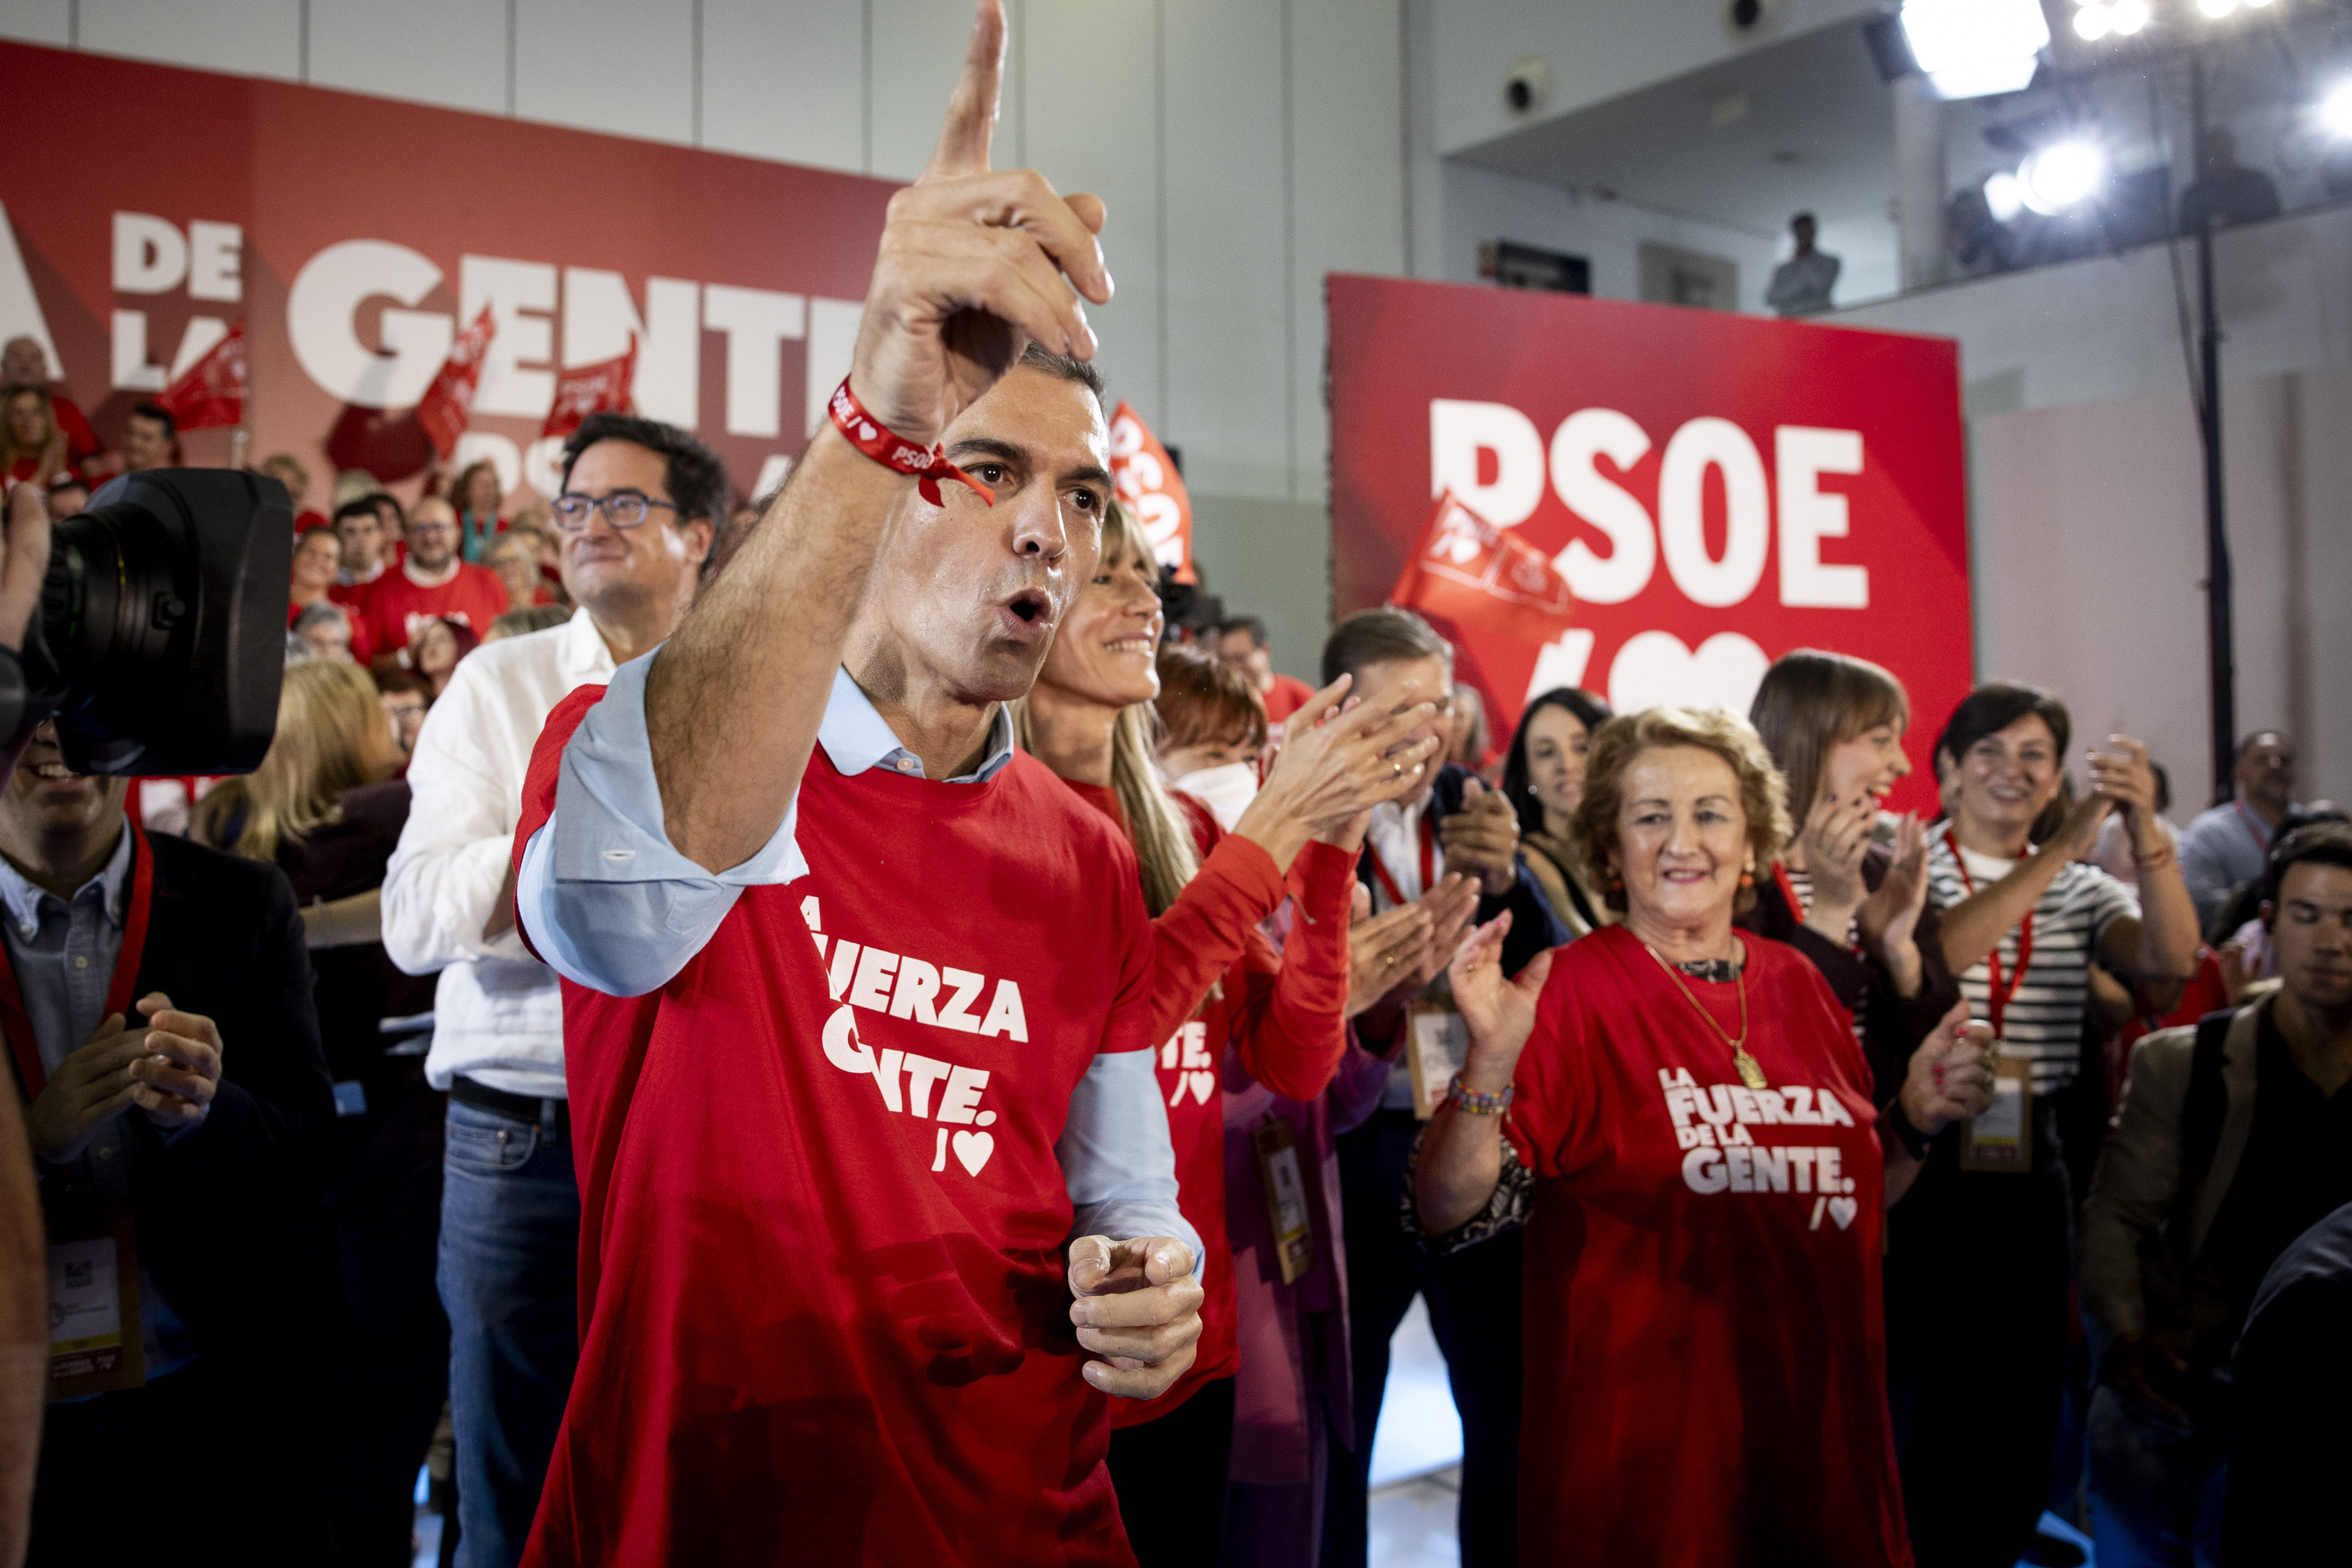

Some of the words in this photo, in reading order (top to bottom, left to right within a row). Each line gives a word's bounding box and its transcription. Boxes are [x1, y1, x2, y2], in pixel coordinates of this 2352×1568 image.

[112, 210, 243, 302] DE
[1429, 397, 1870, 610] PSOE
[811, 933, 1029, 1044] UERZA
[822, 1003, 997, 1126] GNTE.
[1658, 1067, 1697, 1089] LA
[1664, 1083, 1855, 1128] FUERZA
[1676, 1124, 1716, 1150] DE
[1714, 1122, 1755, 1147] LA
[1681, 1145, 1856, 1195] GENTE.
